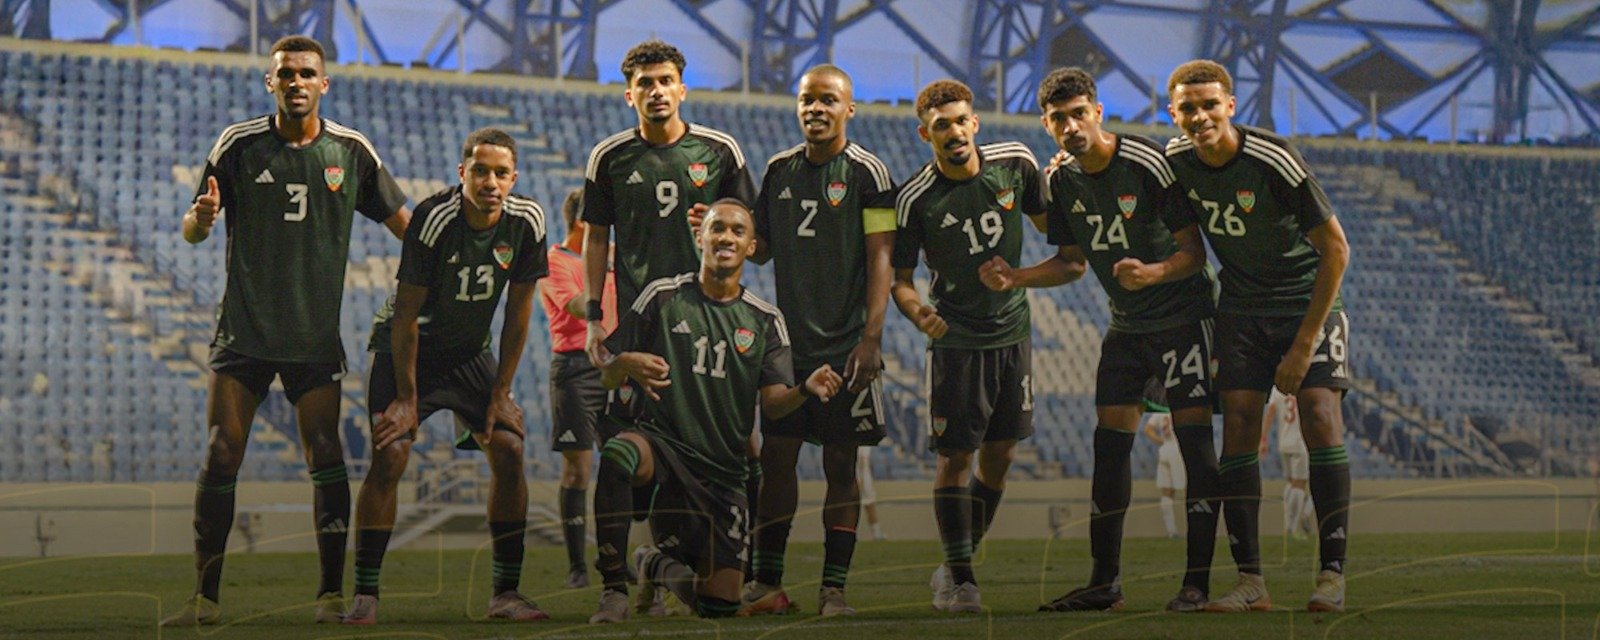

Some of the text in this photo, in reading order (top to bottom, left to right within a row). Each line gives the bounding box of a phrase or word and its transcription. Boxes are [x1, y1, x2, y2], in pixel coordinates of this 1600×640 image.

[284, 183, 308, 222] 3
[655, 180, 679, 218] 9
[796, 199, 819, 237] 2
[962, 209, 1004, 255] 19
[1086, 214, 1131, 251] 24
[1201, 200, 1247, 237] 26
[455, 265, 495, 302] 13
[692, 335, 728, 379] 11
[1311, 325, 1345, 362] 26
[1161, 343, 1205, 389] 24
